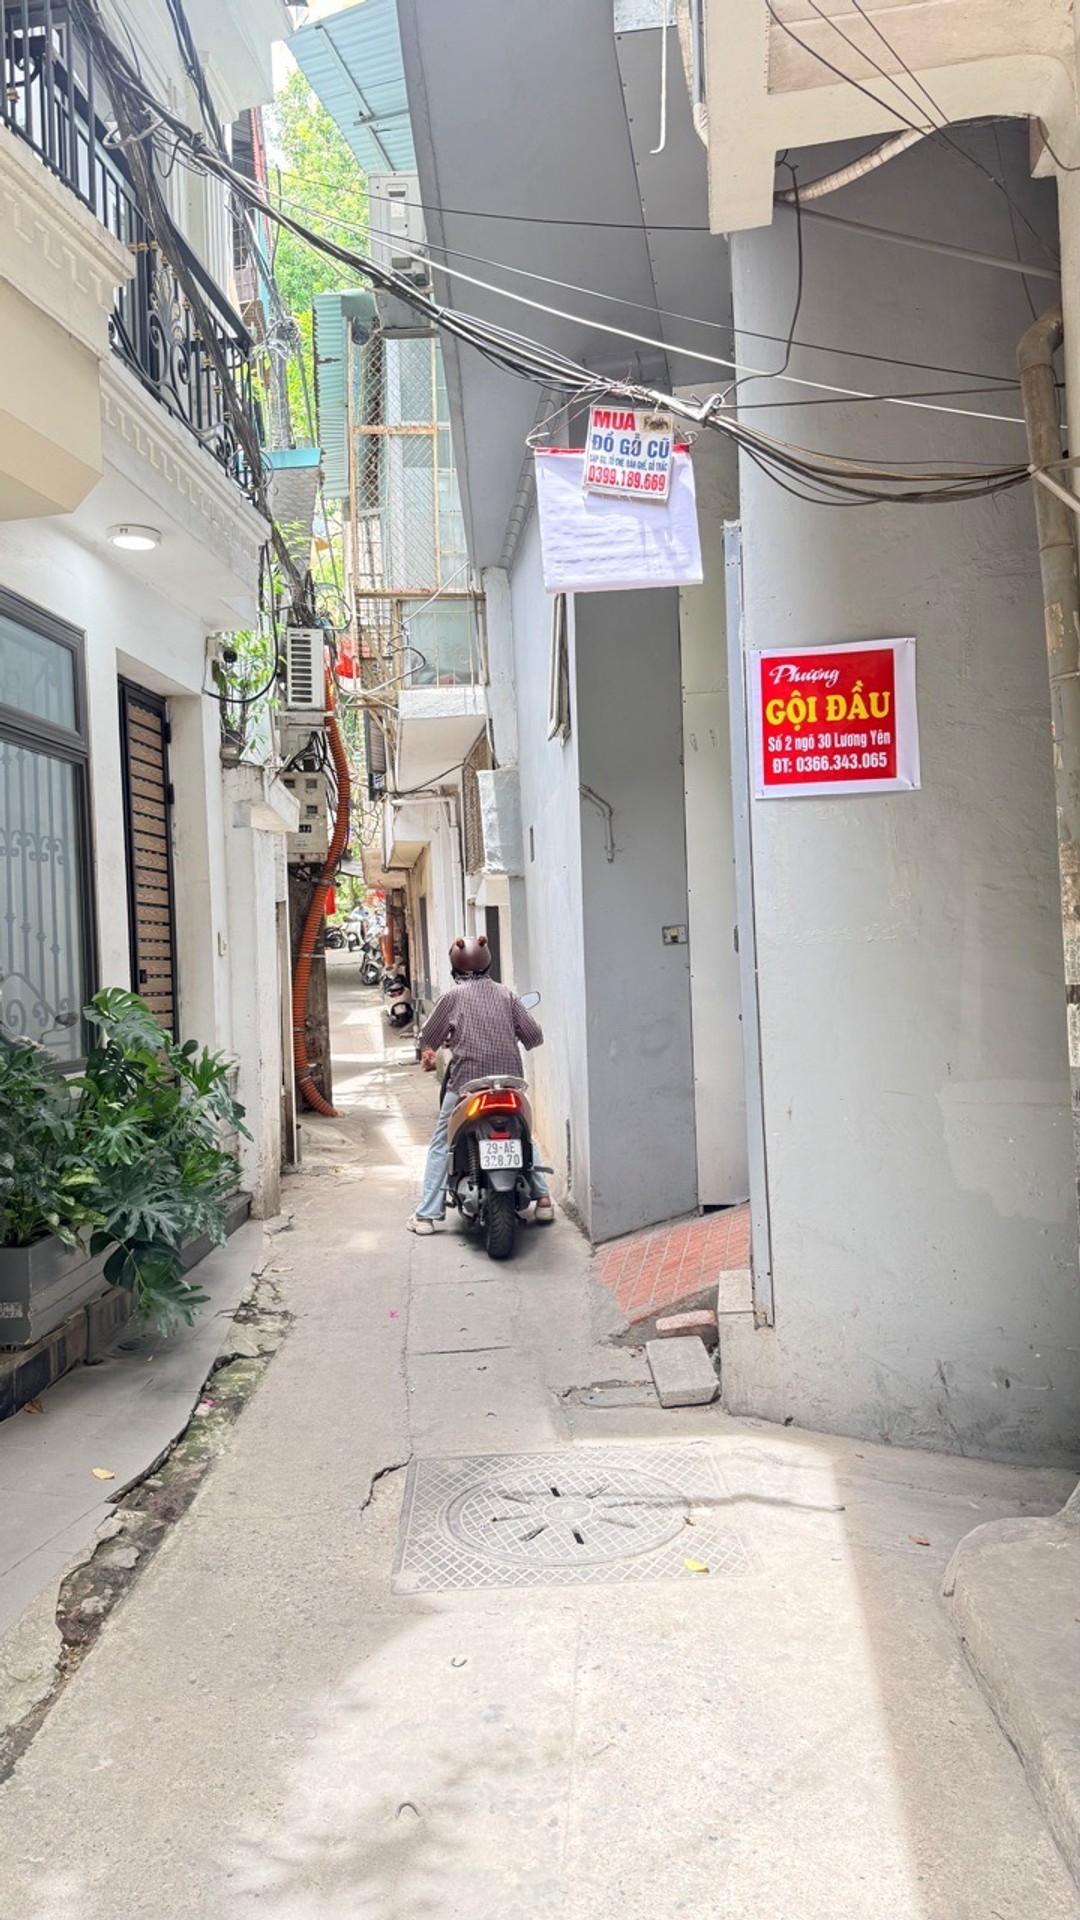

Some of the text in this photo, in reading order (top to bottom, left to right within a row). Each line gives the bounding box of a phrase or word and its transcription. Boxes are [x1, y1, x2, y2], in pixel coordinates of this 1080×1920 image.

[593, 410, 636, 431] MUA
[647, 438, 670, 459] CŨ
[588, 465, 666, 492] 0399.189.669
[769, 664, 840, 688] Phượng
[766, 680, 891, 731] GỘI ĐẦU
[768, 729, 891, 752] Số 2 ngõ 30 Lương Yên
[773, 752, 887, 774] ĐT: 0366.343.065
